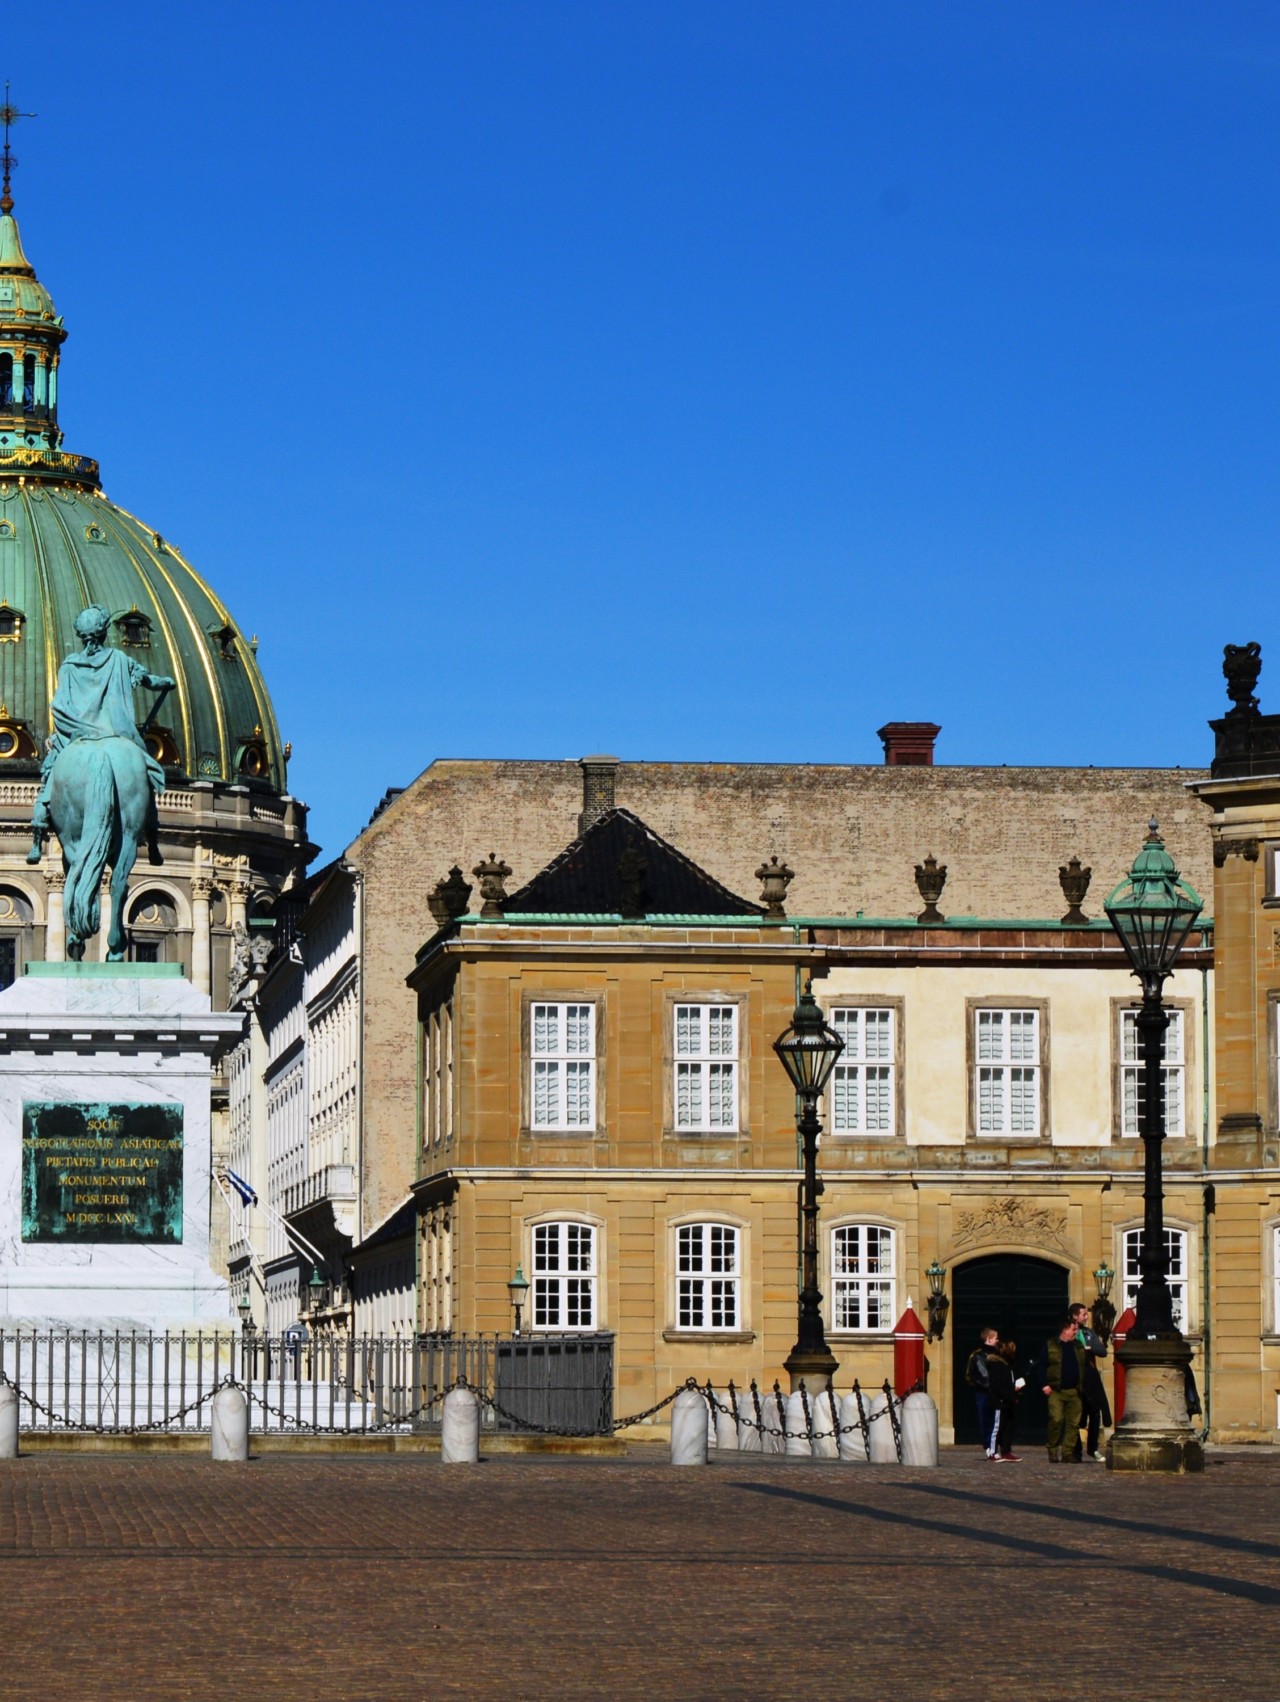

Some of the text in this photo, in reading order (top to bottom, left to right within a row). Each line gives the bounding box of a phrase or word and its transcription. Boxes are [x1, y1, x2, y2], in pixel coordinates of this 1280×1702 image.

[46, 1156, 96, 1167] PIETATIS
[58, 1175, 147, 1186] MONUMENTUM
[75, 1194, 129, 1205] POSUERE
